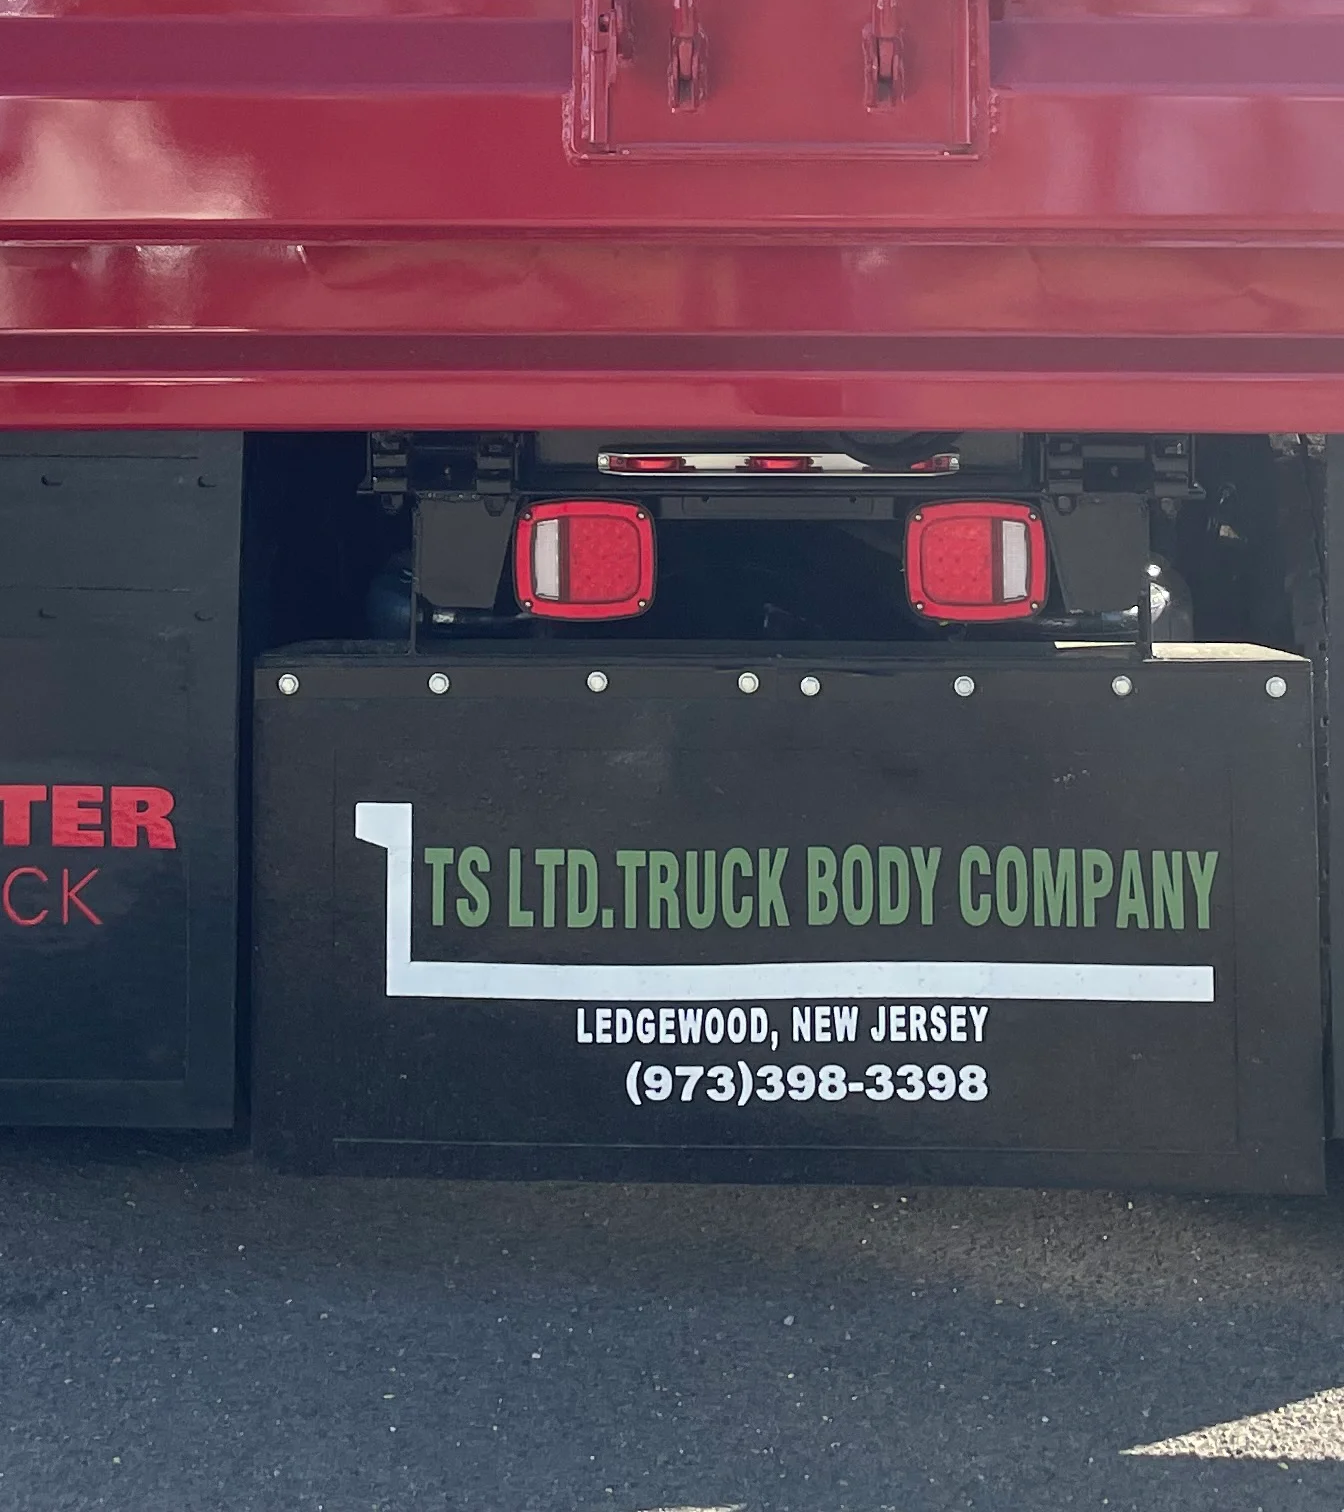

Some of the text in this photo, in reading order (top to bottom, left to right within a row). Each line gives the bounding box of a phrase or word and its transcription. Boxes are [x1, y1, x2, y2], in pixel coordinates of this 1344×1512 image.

[424, 846, 491, 928] TS
[807, 844, 943, 926] BODY
[959, 845, 1219, 930] COMPANY
[576, 1005, 989, 1051] LEDGEWOOD, NEW JERSEY
[625, 1060, 989, 1106] (973)398-3398
